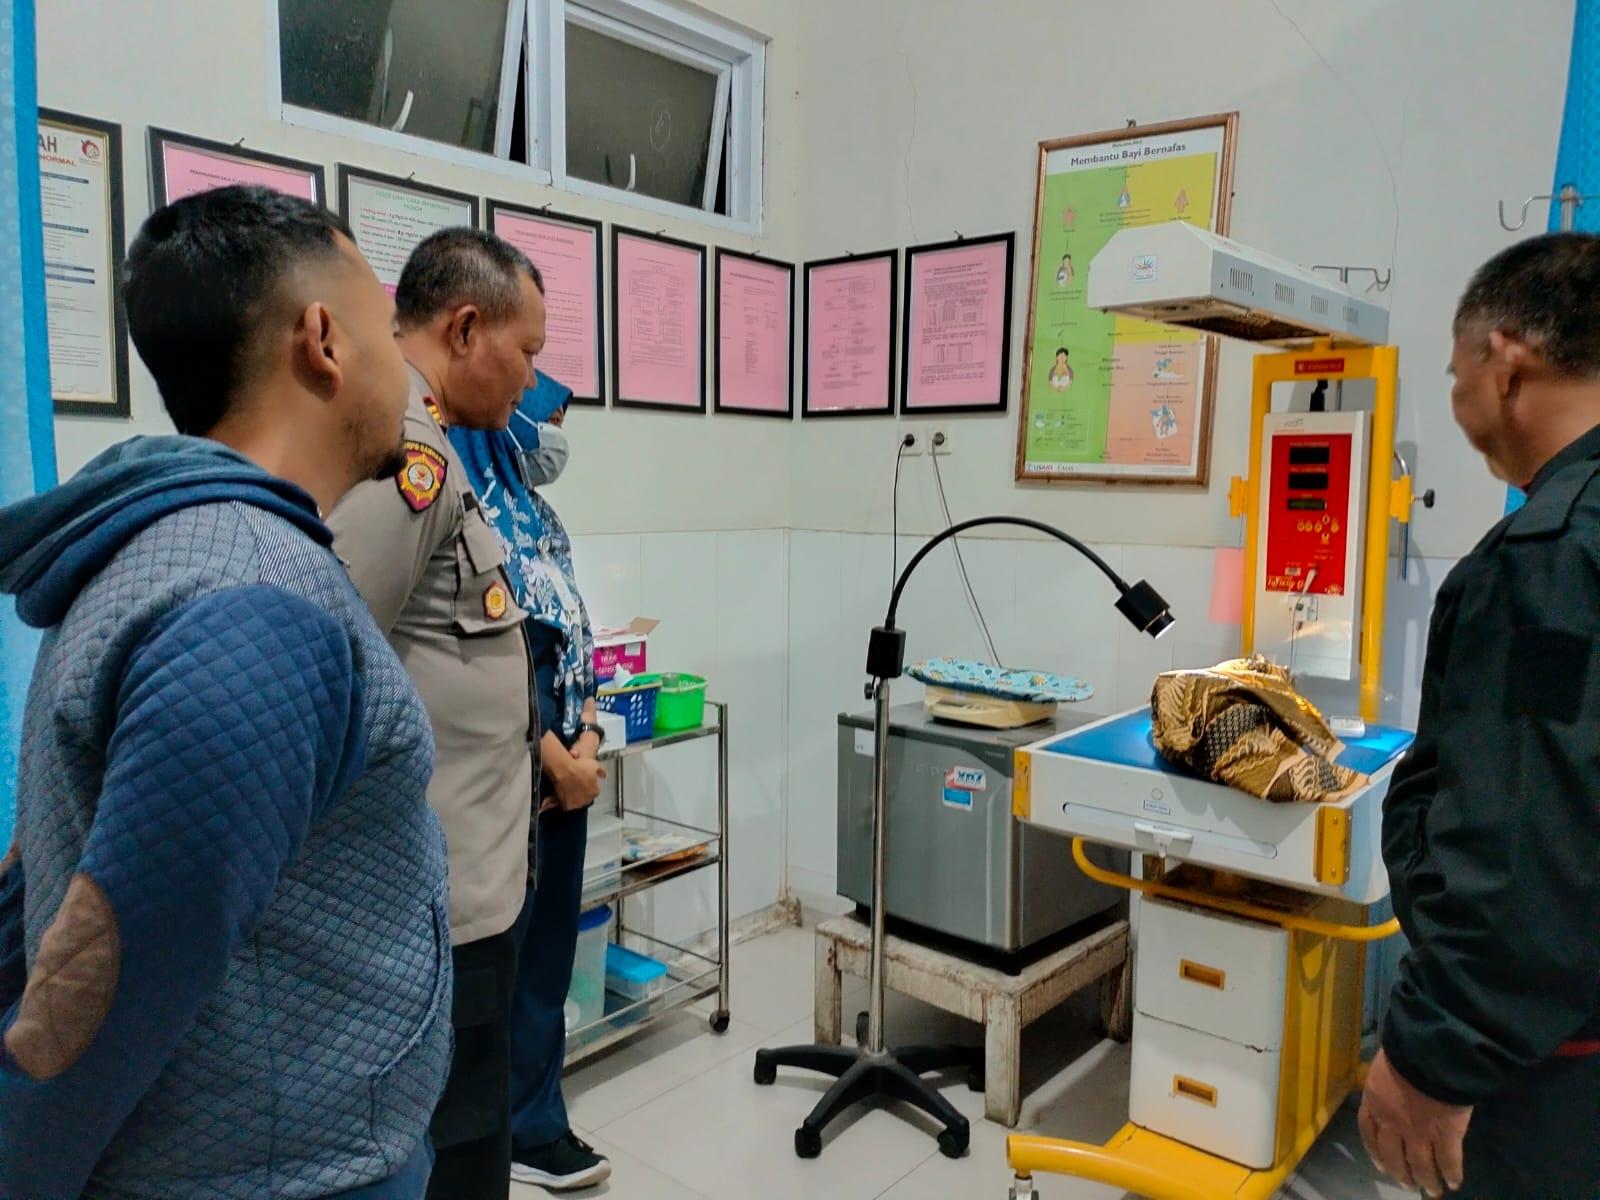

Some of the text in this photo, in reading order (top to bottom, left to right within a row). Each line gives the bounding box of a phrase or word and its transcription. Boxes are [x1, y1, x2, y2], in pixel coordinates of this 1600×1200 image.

[1071, 142, 1186, 166] Membantu Bayi Bernafas
